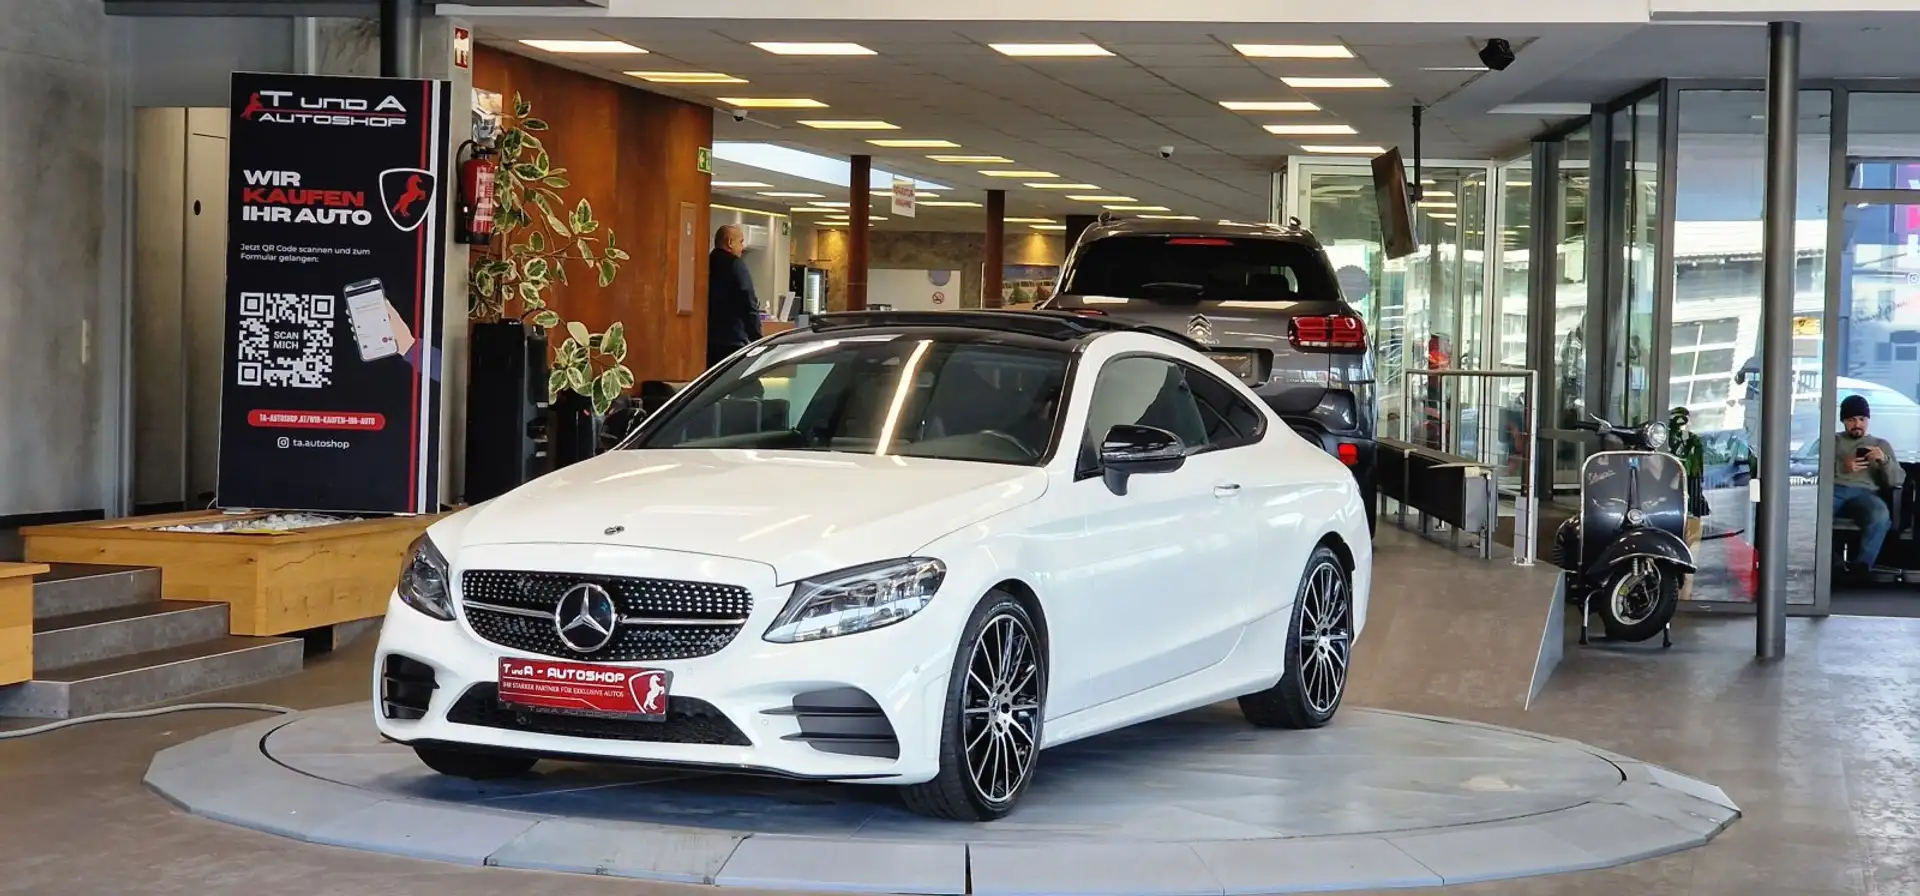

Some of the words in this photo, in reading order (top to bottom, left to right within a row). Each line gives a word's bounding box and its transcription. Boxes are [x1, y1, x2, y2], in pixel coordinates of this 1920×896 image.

[260, 90, 293, 107] T
[374, 95, 407, 112] A
[259, 113, 407, 127] AUTOSHOP
[243, 169, 301, 187] WIR
[243, 188, 364, 206] KAUFEN
[242, 206, 291, 222] IHR
[294, 208, 372, 226] AUTO
[240, 243, 260, 251] Jetzt
[262, 244, 275, 252] QR
[276, 244, 297, 252] Code
[278, 254, 319, 263] gelangen:
[273, 331, 299, 340] SCAN
[273, 340, 299, 350] MICH
[293, 439, 350, 450] ta.autoshop
[503, 664, 511, 674] T
[524, 665, 533, 676] A
[547, 667, 625, 684] AUTOSHOP
[535, 684, 559, 692] PARTNER
[604, 690, 624, 698] AUTOS
